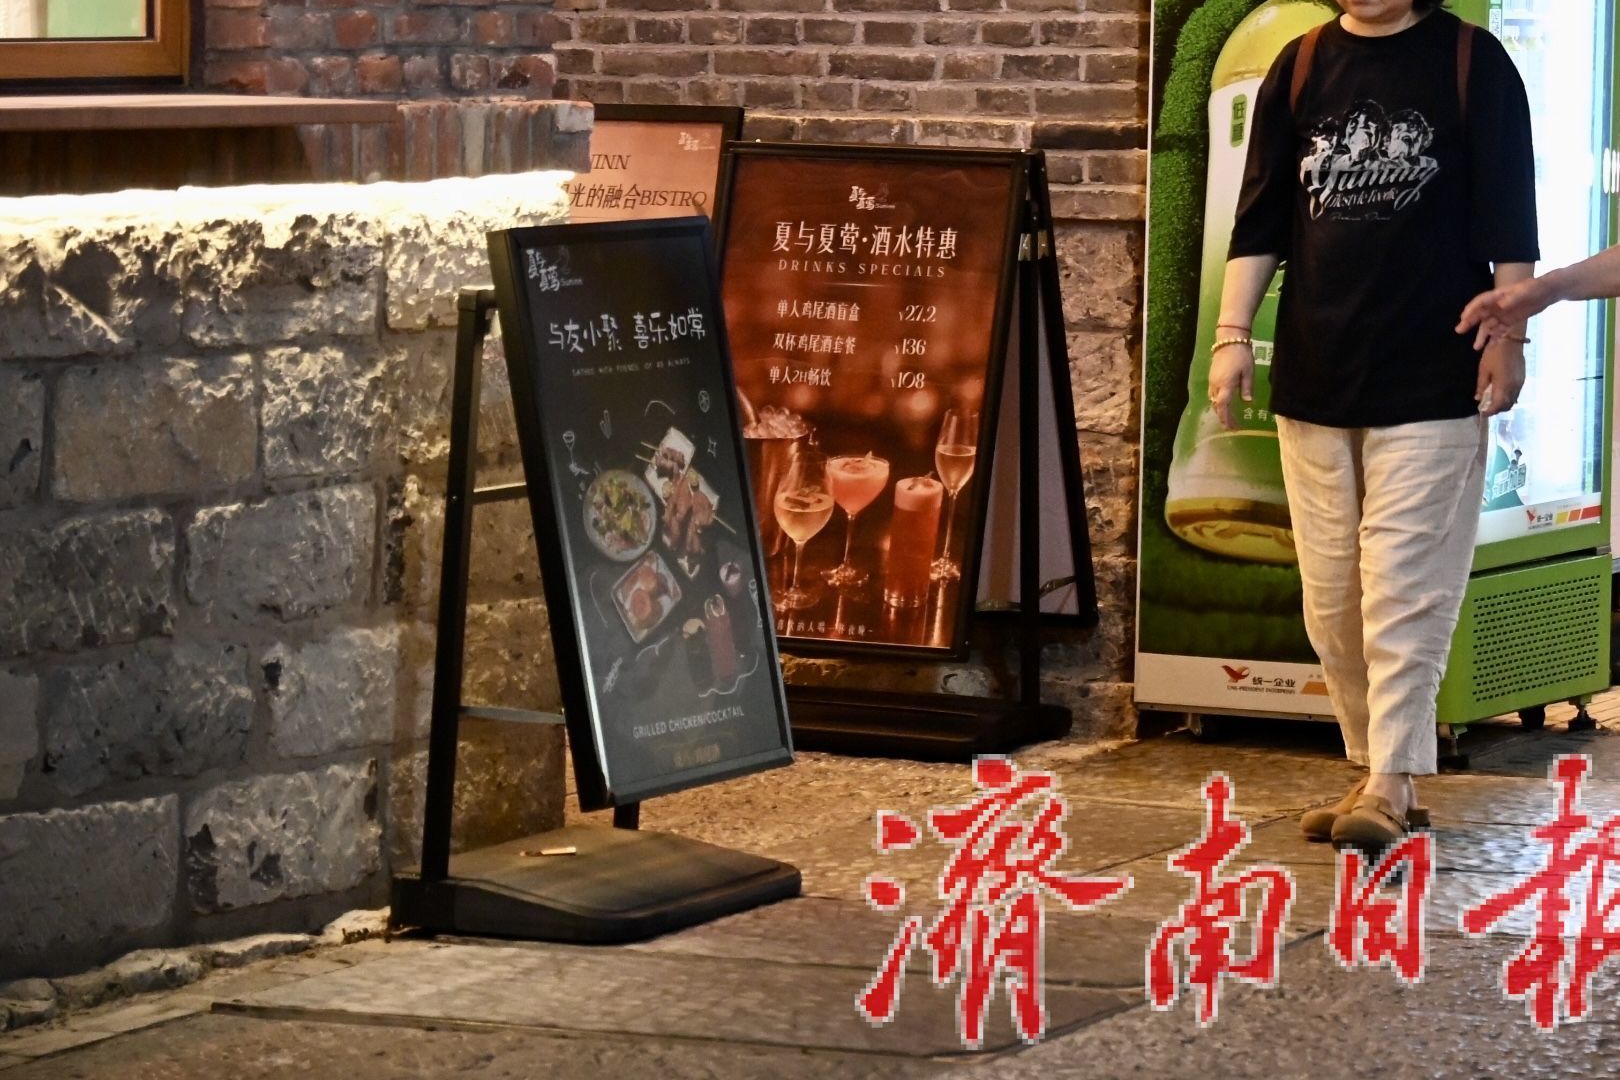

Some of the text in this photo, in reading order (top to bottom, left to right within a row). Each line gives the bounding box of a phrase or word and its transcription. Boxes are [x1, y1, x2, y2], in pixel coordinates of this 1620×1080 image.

[778, 259, 946, 278] DRINKS SPECIALS
[777, 299, 861, 322] 单人鸡尾酒盲盒
[548, 307, 706, 354] 与友小聚 喜乐如常
[633, 720, 668, 739] GRILLED
